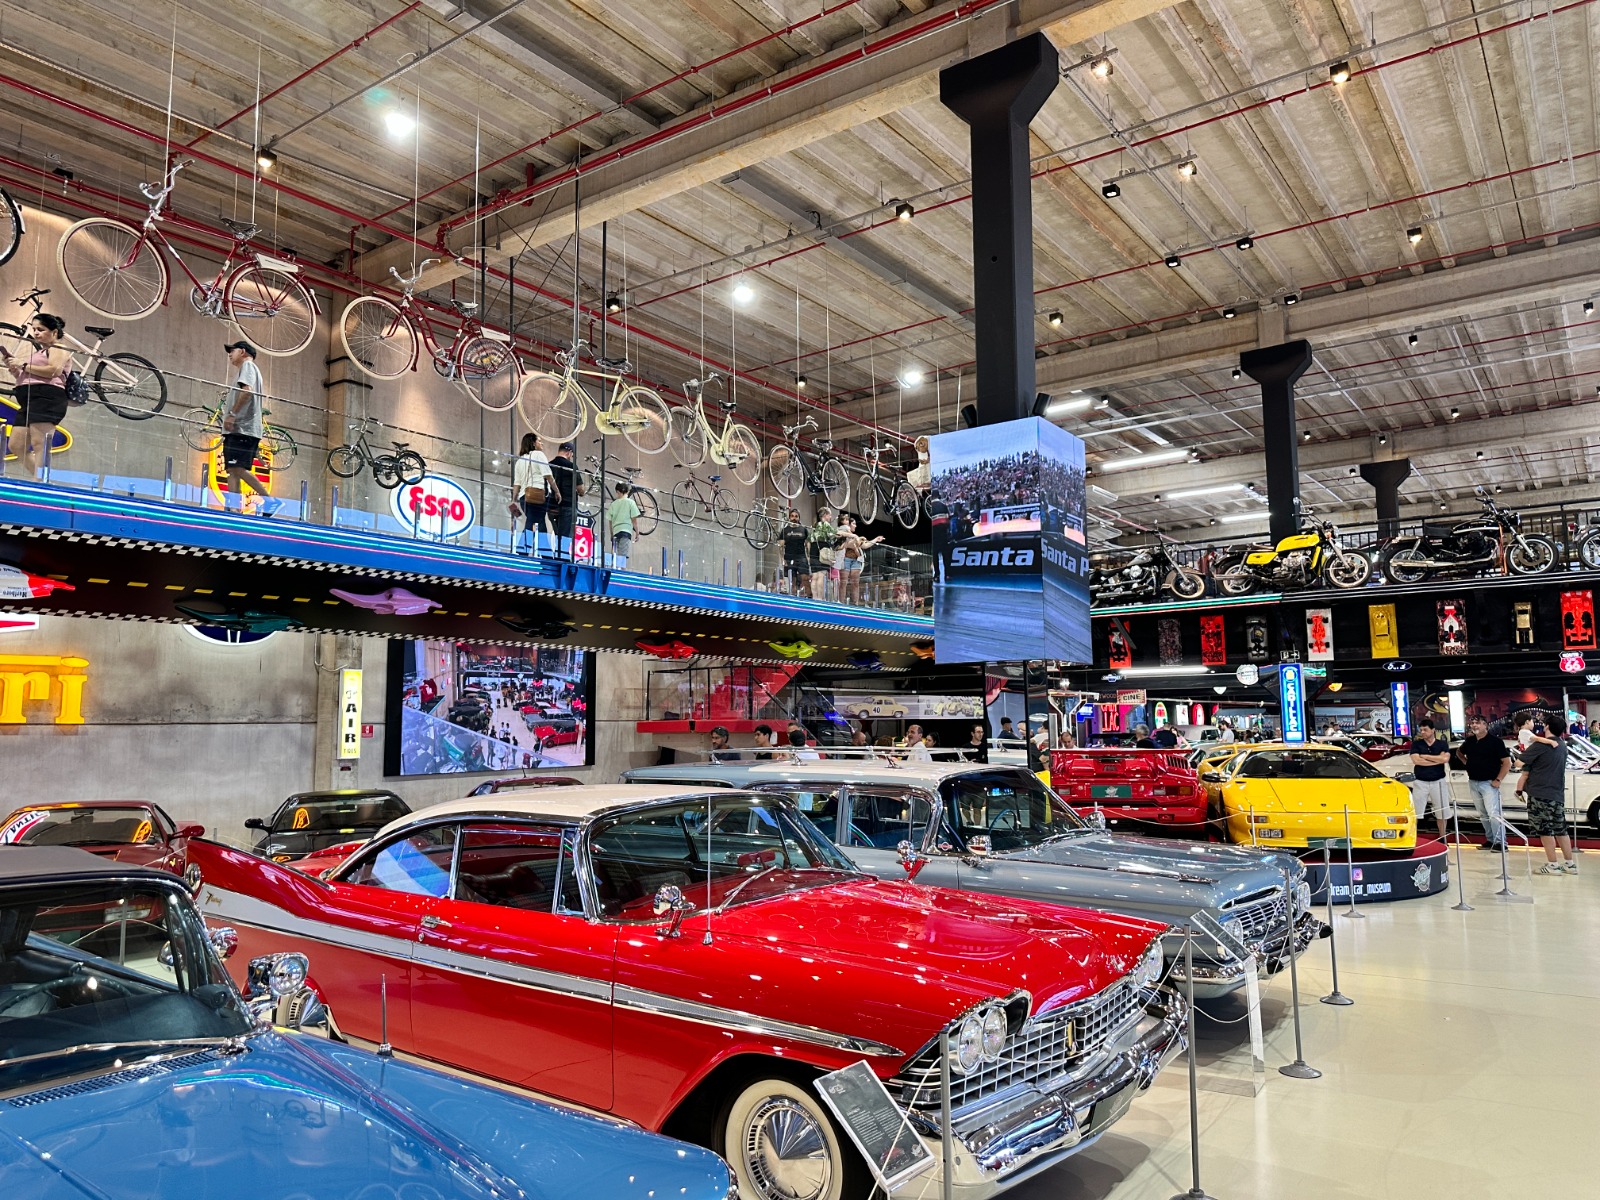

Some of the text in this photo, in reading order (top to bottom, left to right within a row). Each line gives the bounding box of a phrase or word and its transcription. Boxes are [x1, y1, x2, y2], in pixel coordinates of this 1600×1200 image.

[950, 546, 1035, 567] Santa
[1041, 537, 1077, 574] Santa
[1565, 660, 1581, 671] 66
[1122, 692, 1142, 701] CINE
[872, 706, 881, 714] 40
[344, 703, 358, 743] AIR
